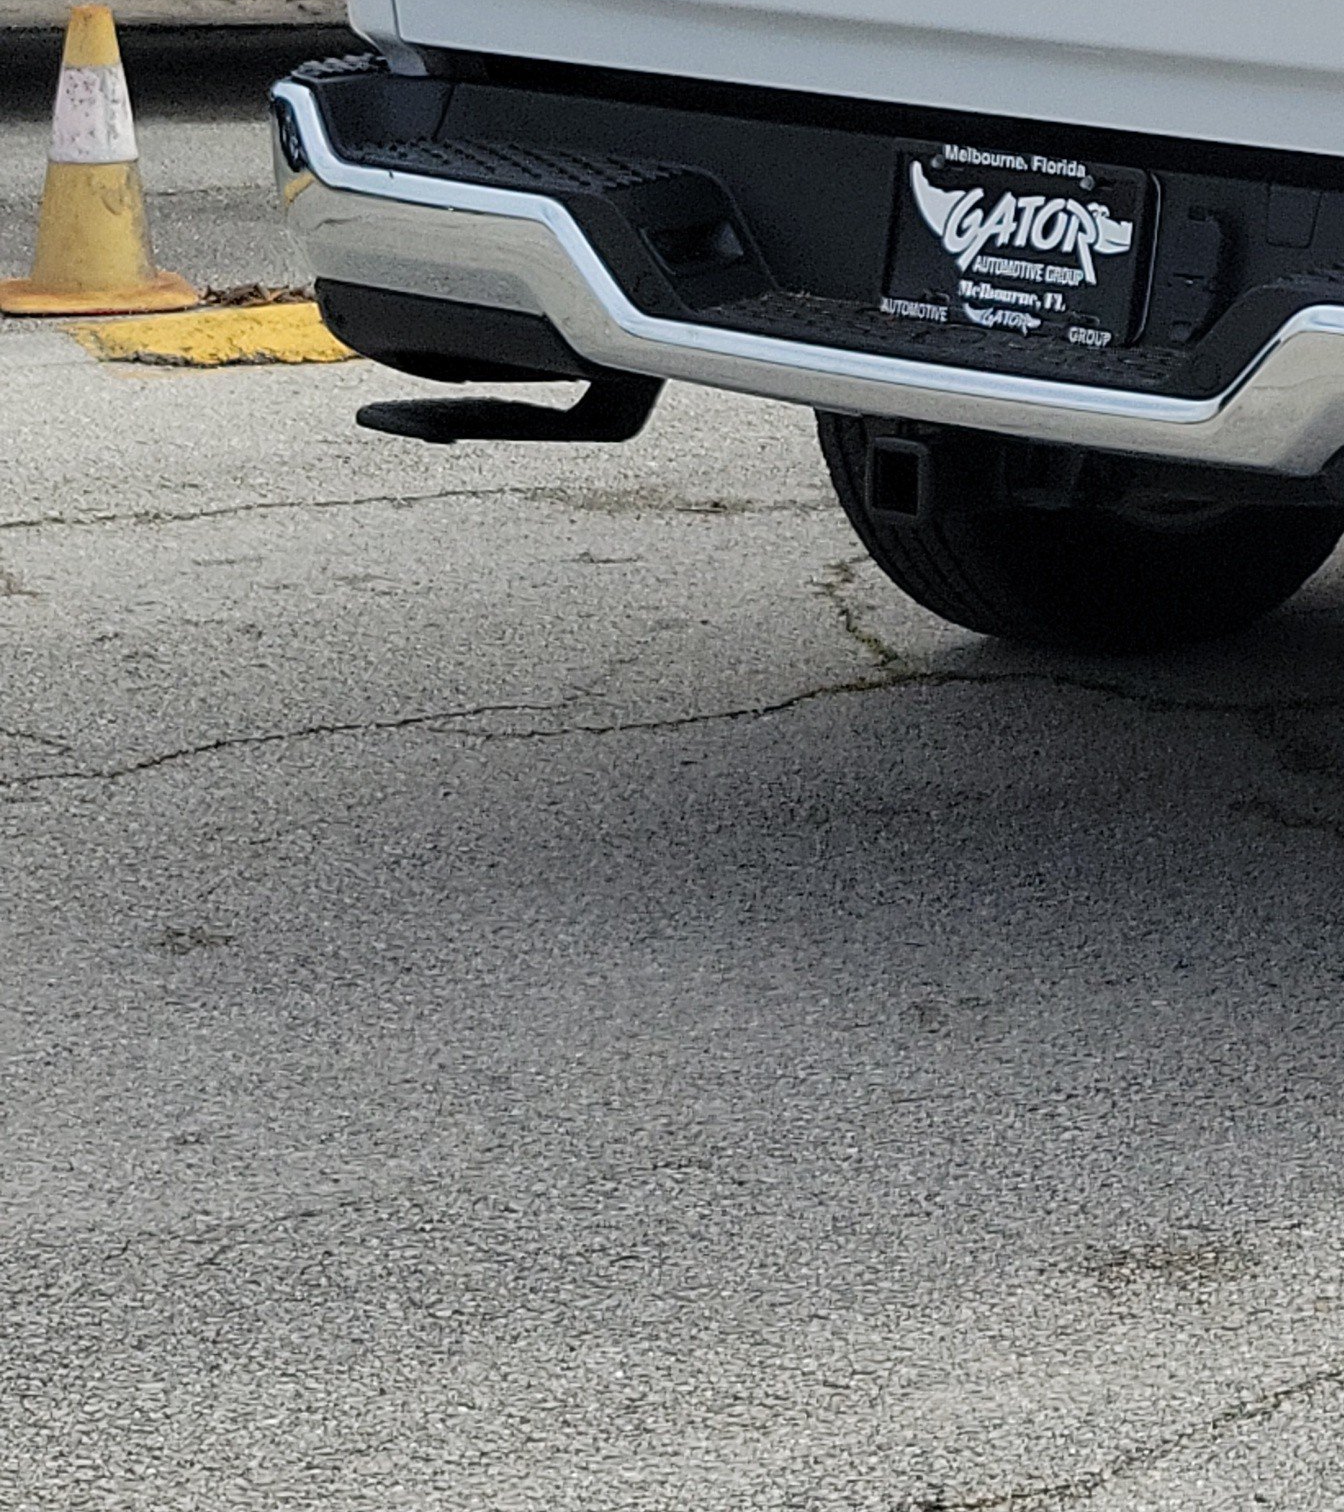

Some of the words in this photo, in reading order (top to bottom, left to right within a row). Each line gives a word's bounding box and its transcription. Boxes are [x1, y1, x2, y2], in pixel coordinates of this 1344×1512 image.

[1032, 155, 1087, 179] Florida
[942, 187, 1098, 286] GATOR
[971, 255, 1044, 282] AUTOMOTIVE
[1044, 264, 1084, 287] GROUP
[879, 296, 949, 322] AUTOMOTIVE
[982, 305, 1030, 337] GATOR
[1067, 326, 1112, 347] GROUP
